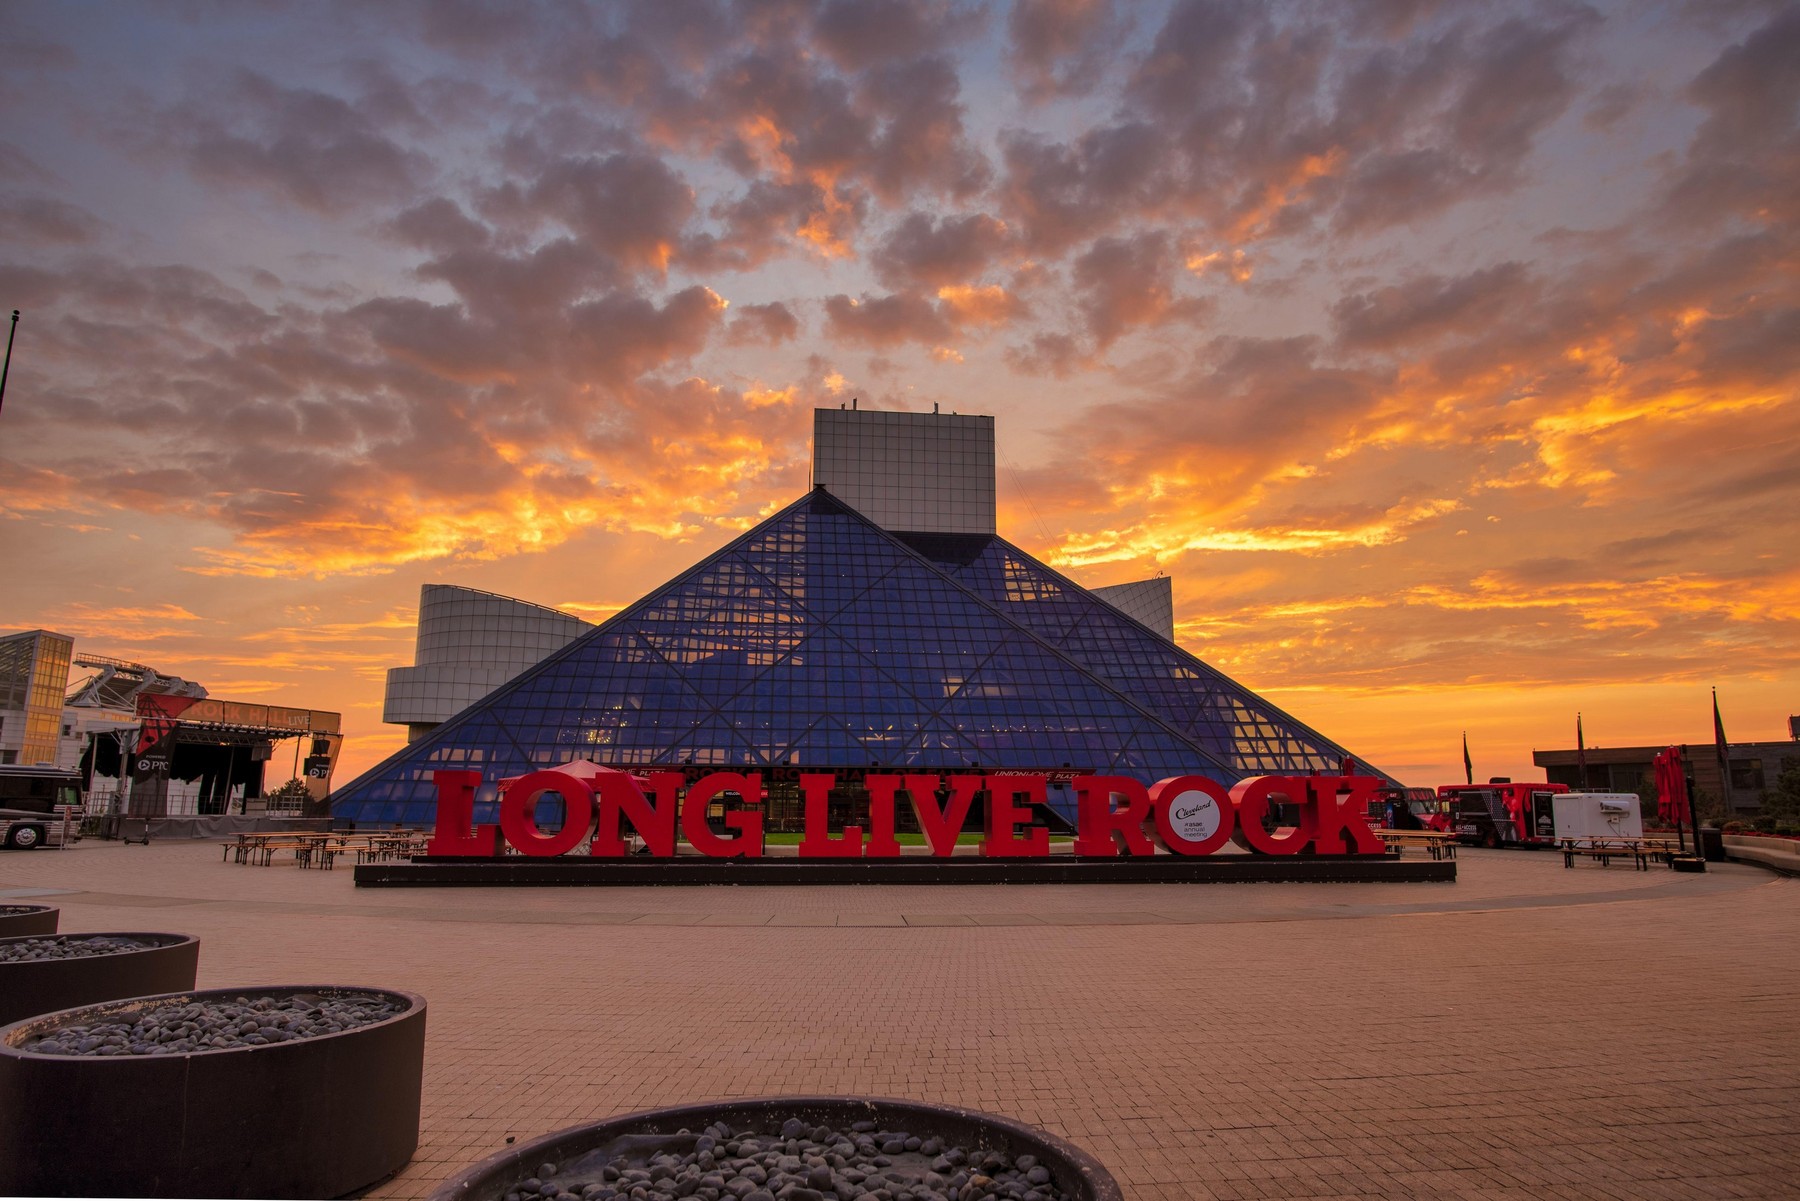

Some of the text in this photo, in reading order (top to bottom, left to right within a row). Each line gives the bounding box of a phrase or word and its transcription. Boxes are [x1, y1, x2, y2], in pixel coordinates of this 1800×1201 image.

[191, 702, 289, 724] ROCK HALL
[288, 715, 311, 726] LIVE
[427, 770, 1386, 857] LONG LIVE ROCK
[1175, 799, 1211, 820] Cleveland
